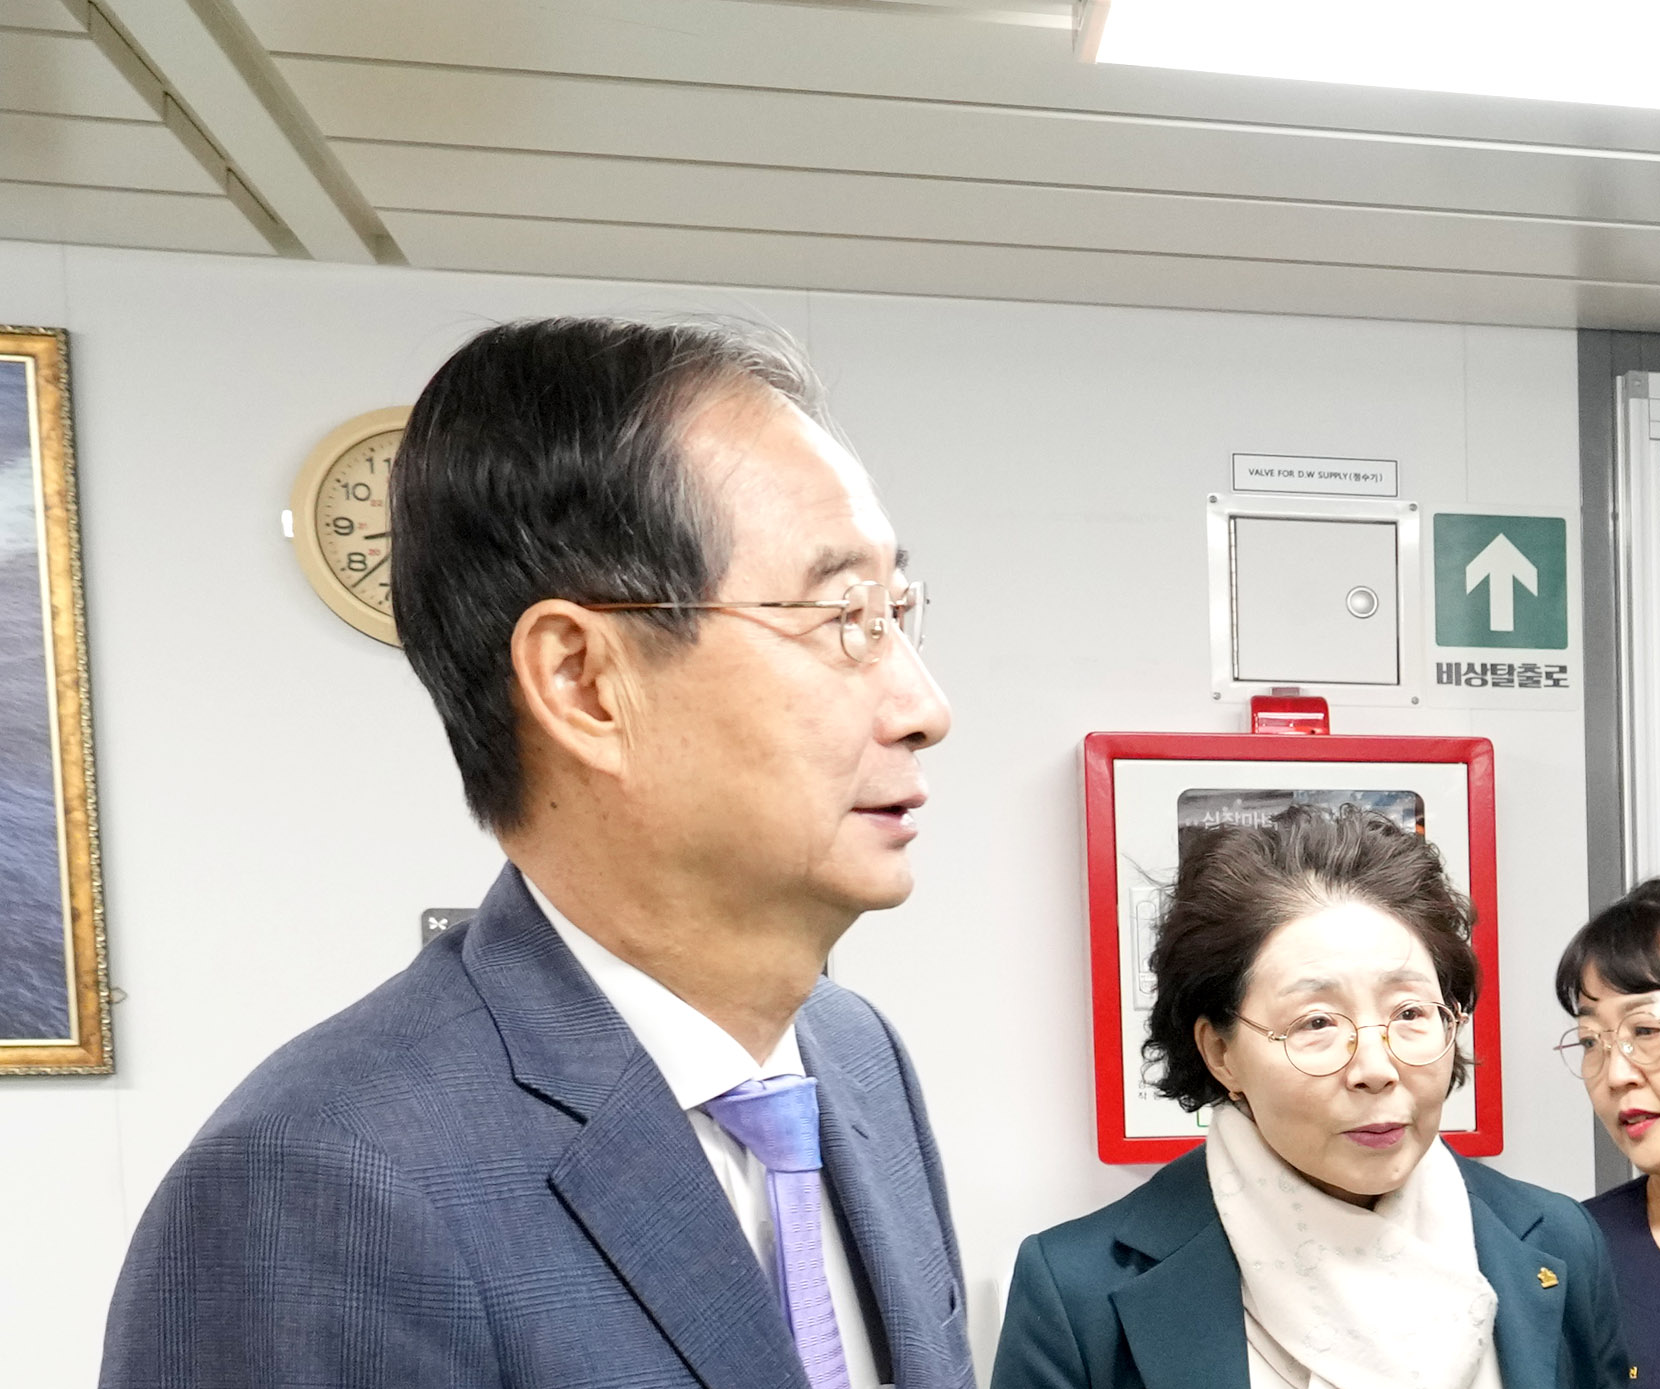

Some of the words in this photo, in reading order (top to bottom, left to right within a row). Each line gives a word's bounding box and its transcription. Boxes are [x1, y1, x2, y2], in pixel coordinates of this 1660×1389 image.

[1248, 468, 1275, 477] VALVE
[1277, 469, 1295, 478] FOR
[341, 482, 371, 501] 10
[332, 516, 355, 536] 9
[347, 551, 367, 572] 8
[1435, 662, 1571, 689] 비상탈출로
